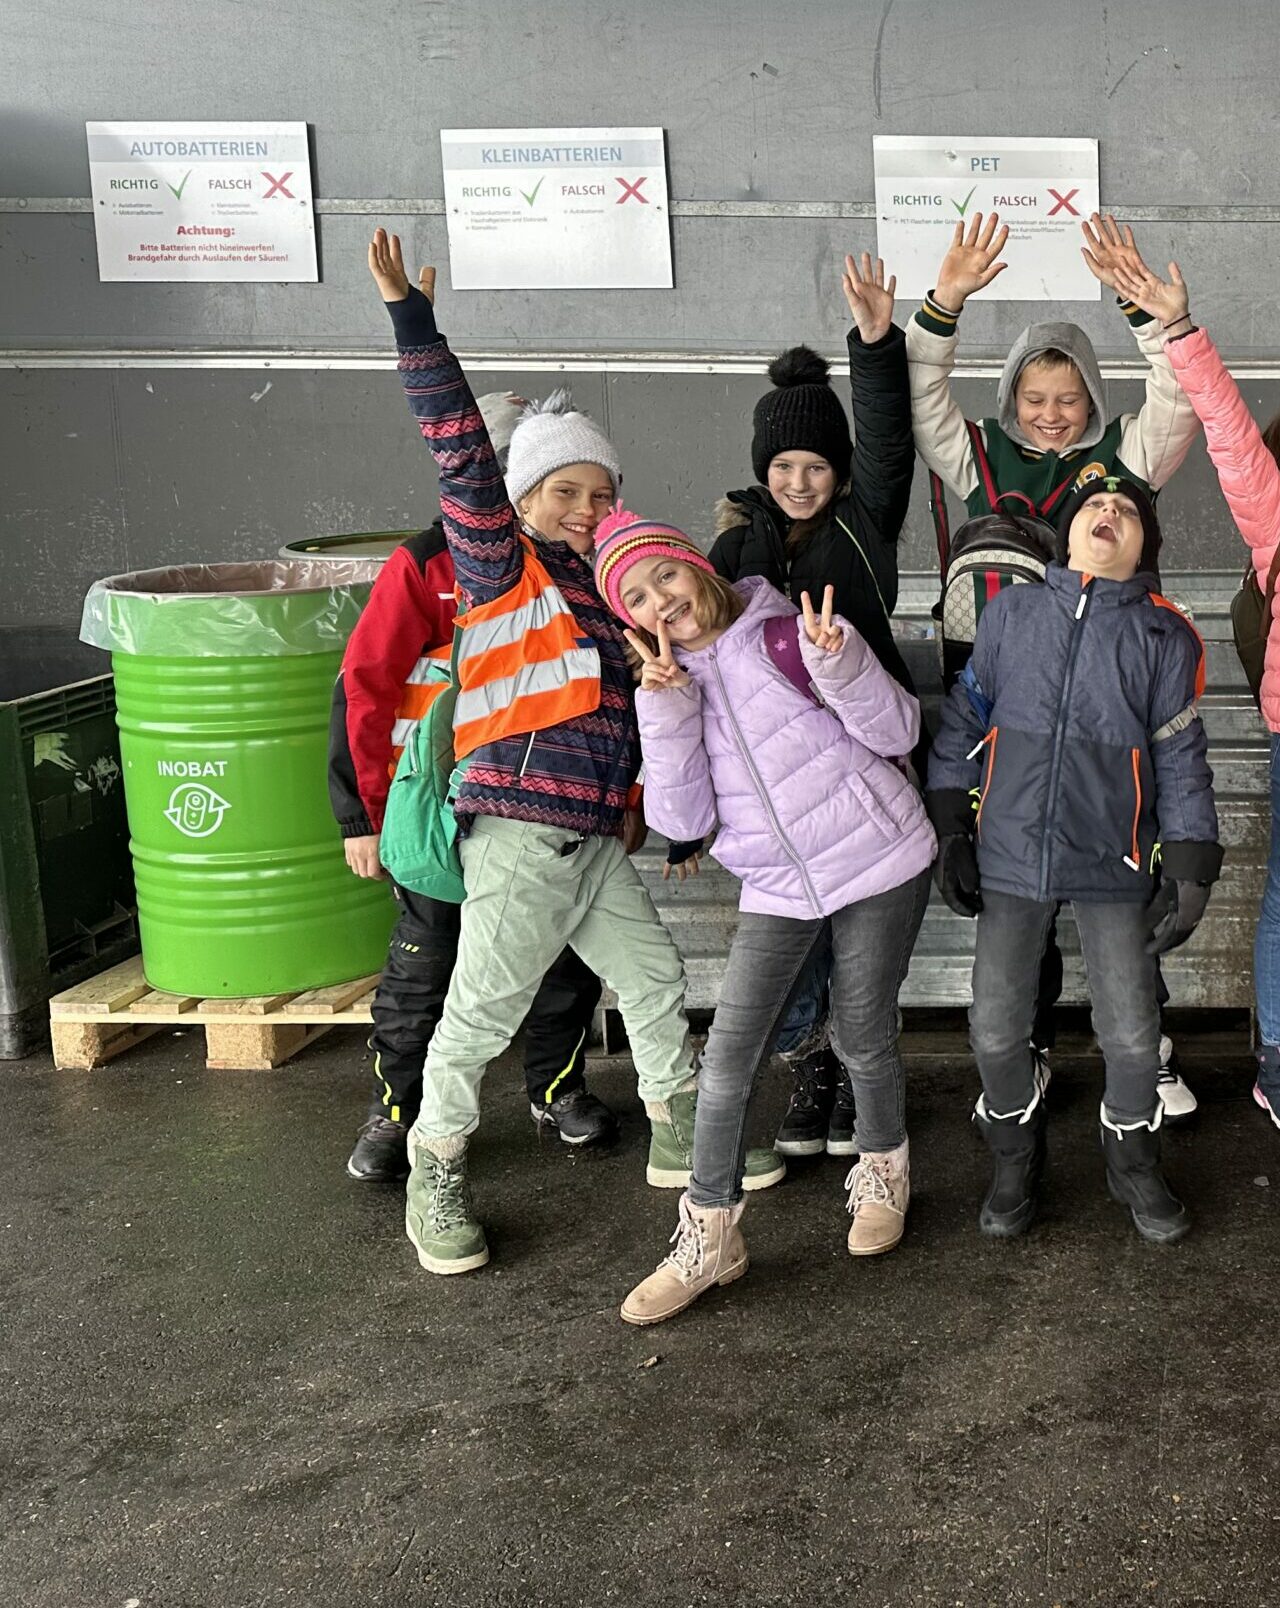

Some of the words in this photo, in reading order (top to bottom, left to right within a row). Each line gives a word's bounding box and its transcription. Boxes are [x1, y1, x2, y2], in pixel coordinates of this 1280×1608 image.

[130, 141, 269, 156] AUTOBATTERIEN
[481, 147, 623, 163] KLEINBATTERIEN
[971, 157, 1001, 172] PET
[110, 179, 159, 190] RICHTIG
[208, 179, 252, 190] FALSCH
[462, 187, 512, 197] RICHTIG
[561, 185, 606, 196] FALSCH
[893, 195, 942, 206] RICHTIG
[993, 196, 1037, 206] FALSCH
[177, 225, 236, 238] Achtung:
[128, 254, 176, 263] Brandgefahr
[178, 254, 200, 262] durch
[202, 254, 242, 262] Auslaufen
[244, 254, 256, 262] der
[259, 254, 289, 262] Säuren!
[157, 760, 228, 777] INOBAT
